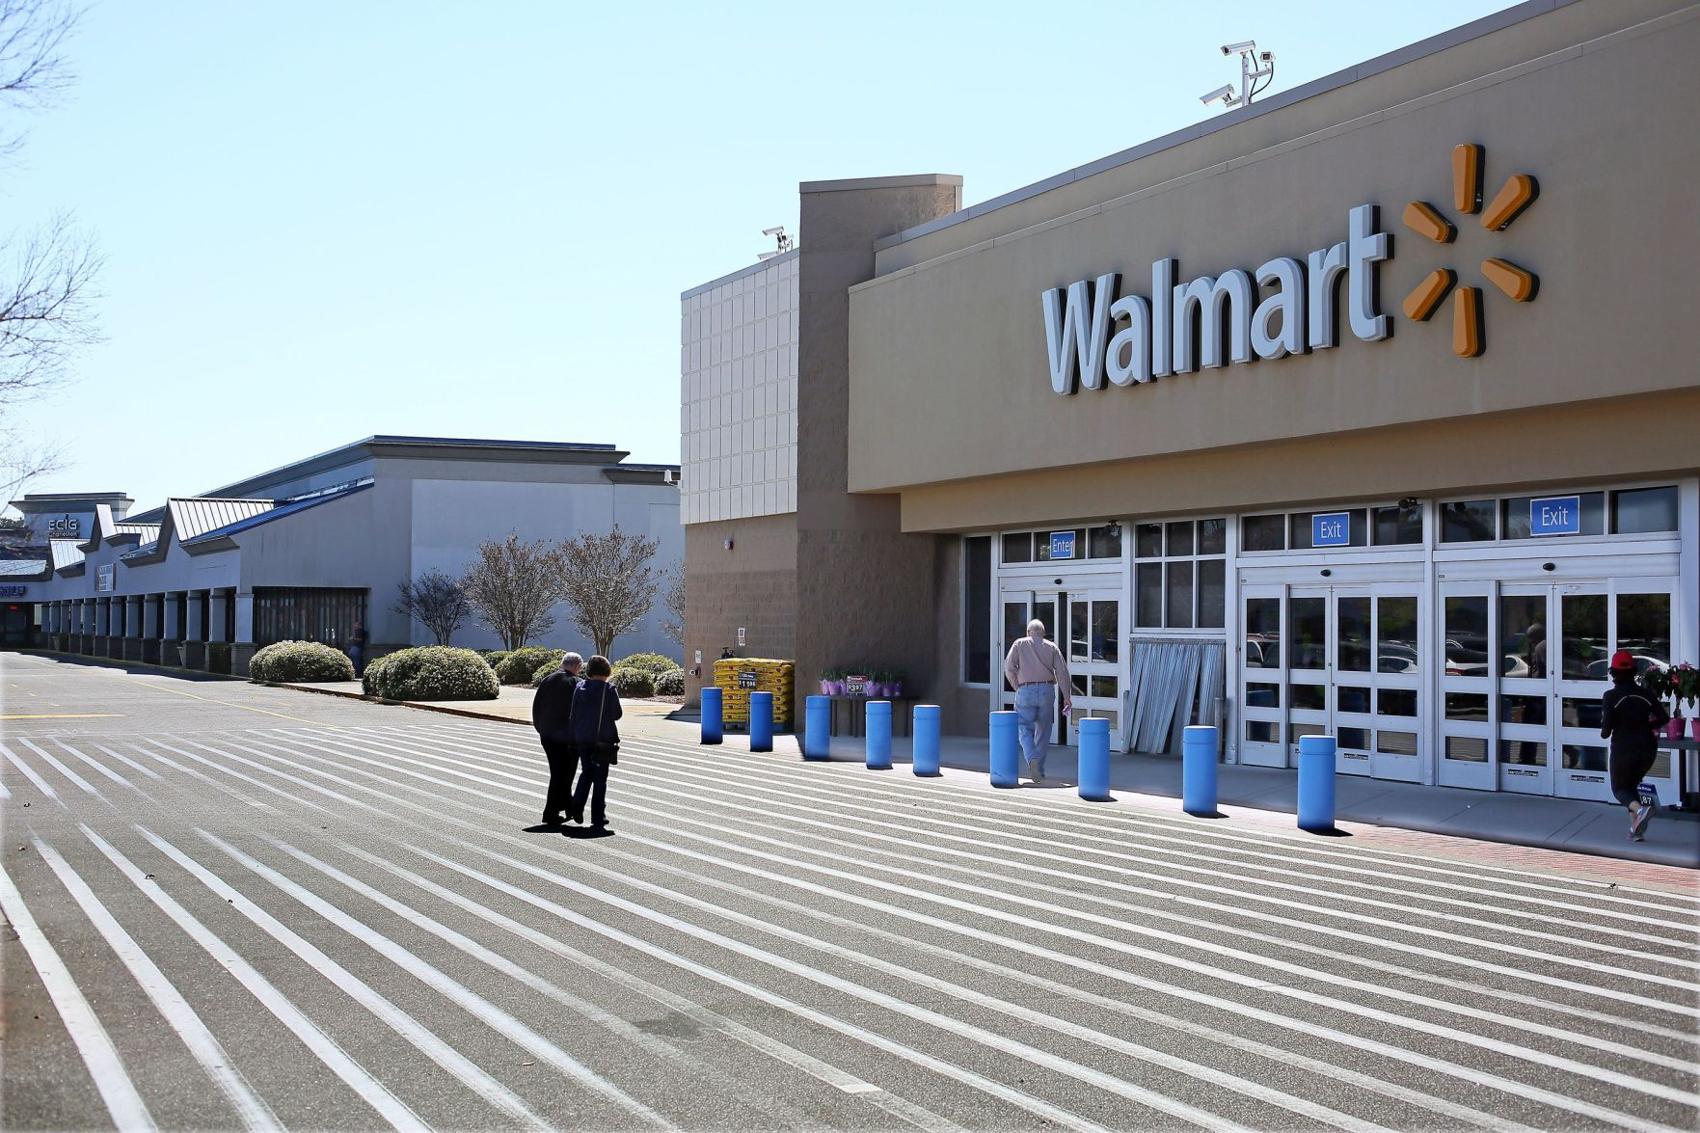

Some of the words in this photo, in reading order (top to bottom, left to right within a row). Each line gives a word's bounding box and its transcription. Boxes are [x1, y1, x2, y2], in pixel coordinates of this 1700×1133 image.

[1041, 203, 1388, 396] Walmart
[1542, 505, 1569, 527] Exit
[1320, 521, 1342, 539] Exit
[1052, 538, 1074, 553] Enter
